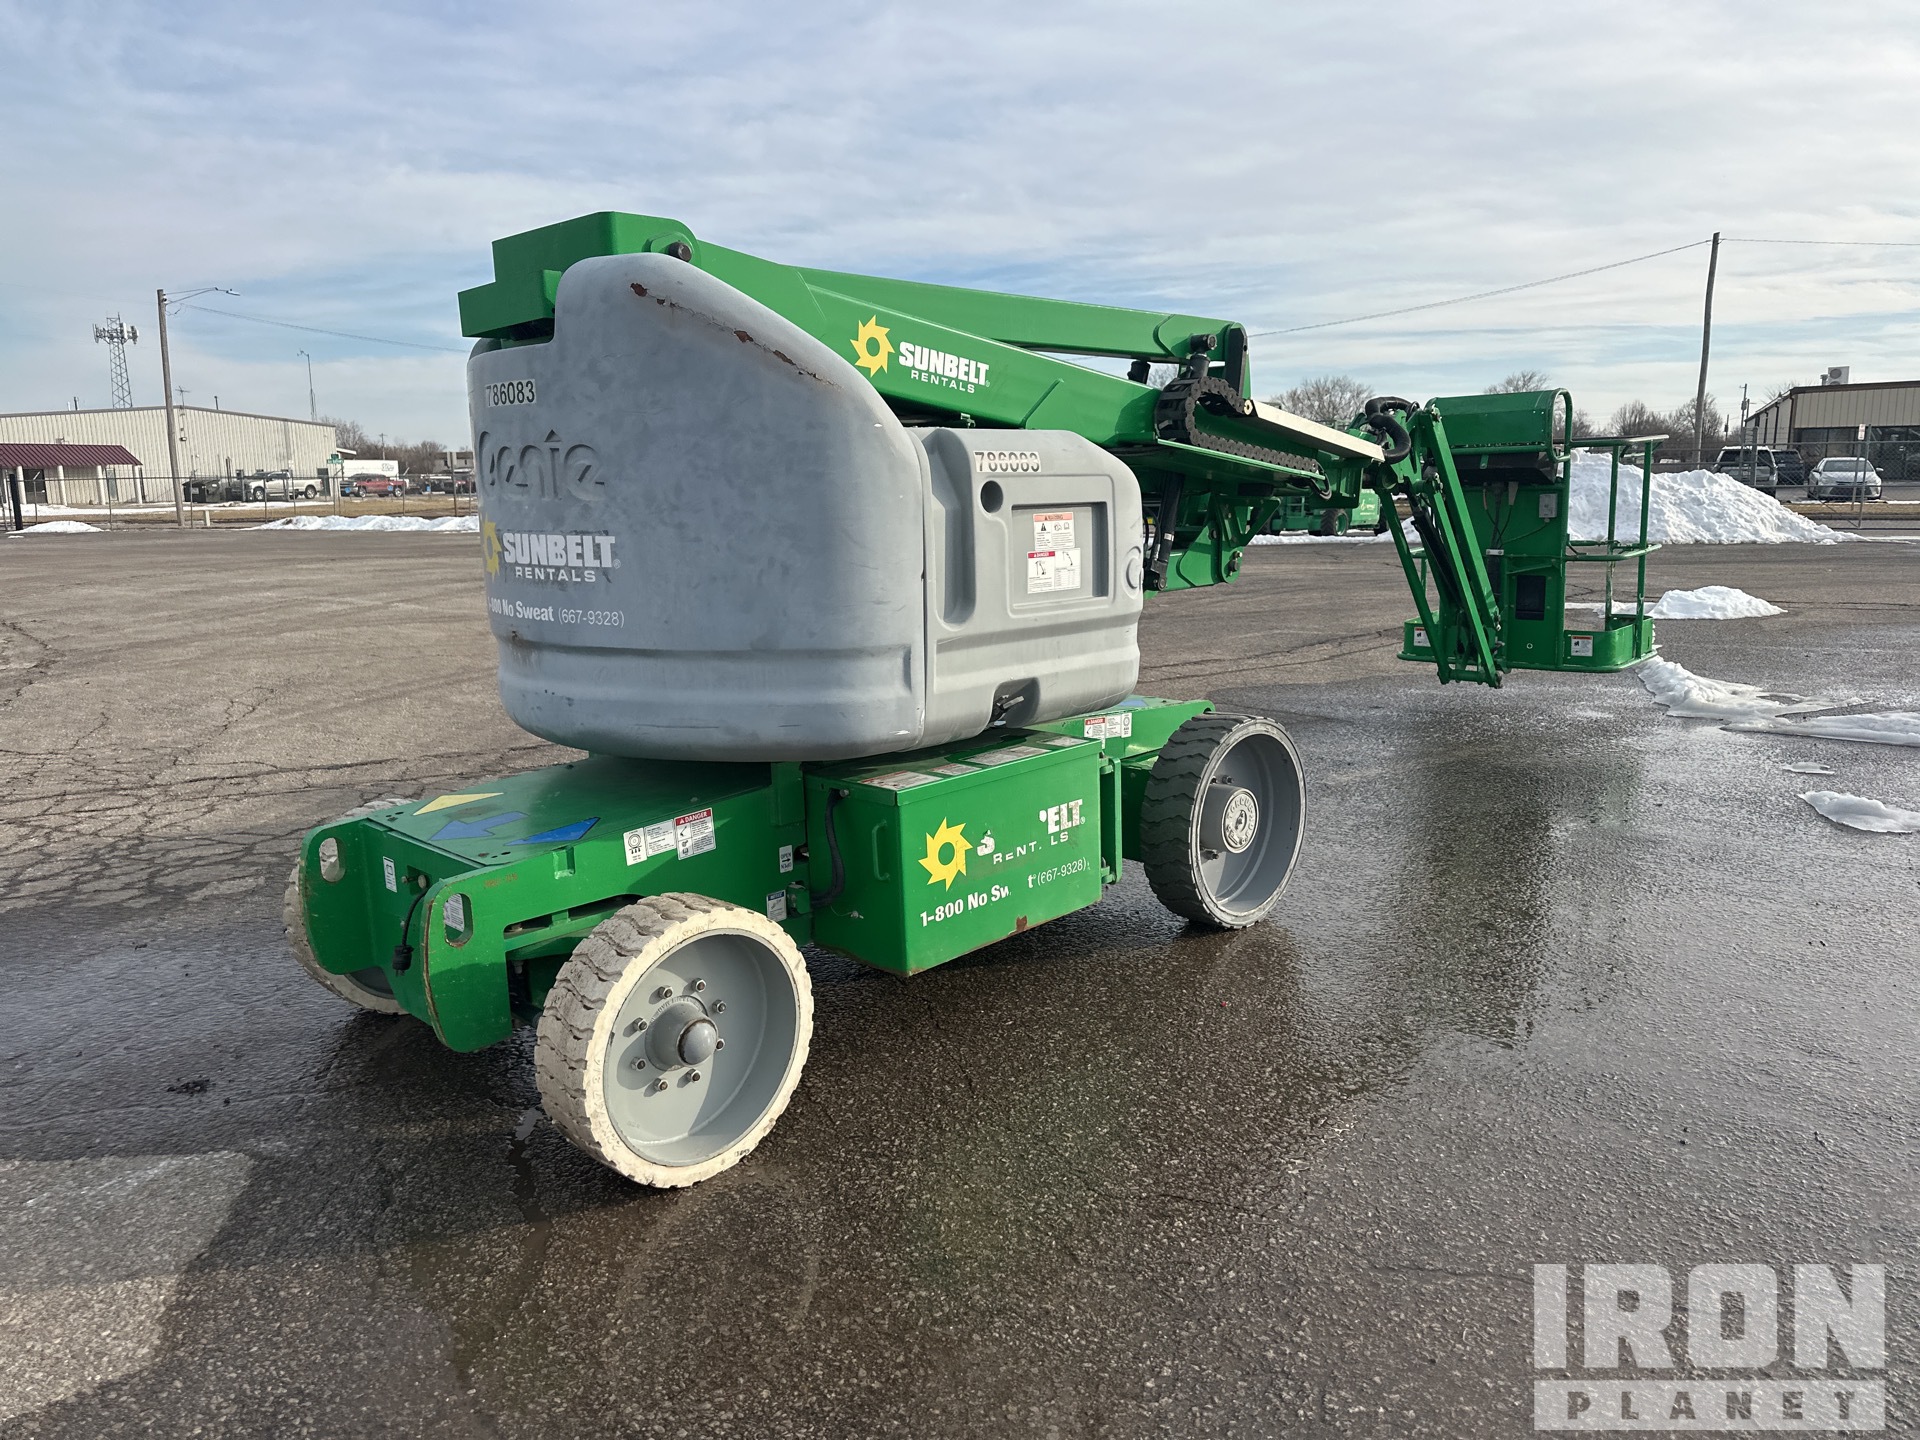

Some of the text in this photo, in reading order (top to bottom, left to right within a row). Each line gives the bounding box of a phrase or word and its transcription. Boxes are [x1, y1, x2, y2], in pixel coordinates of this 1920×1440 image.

[899, 341, 989, 386] SUNBELT
[486, 380, 535, 406] 786083
[911, 370, 975, 393] RENTALS
[503, 533, 616, 568] SUNBELT
[515, 566, 596, 583] RENTALS
[502, 599, 514, 617] No
[516, 601, 554, 621] Sweat
[558, 607, 625, 628] (667-9328)
[685, 811, 708, 823] DANGER
[993, 832, 1069, 865] RENTLS
[920, 899, 964, 927] 1-800
[967, 892, 988, 910] No
